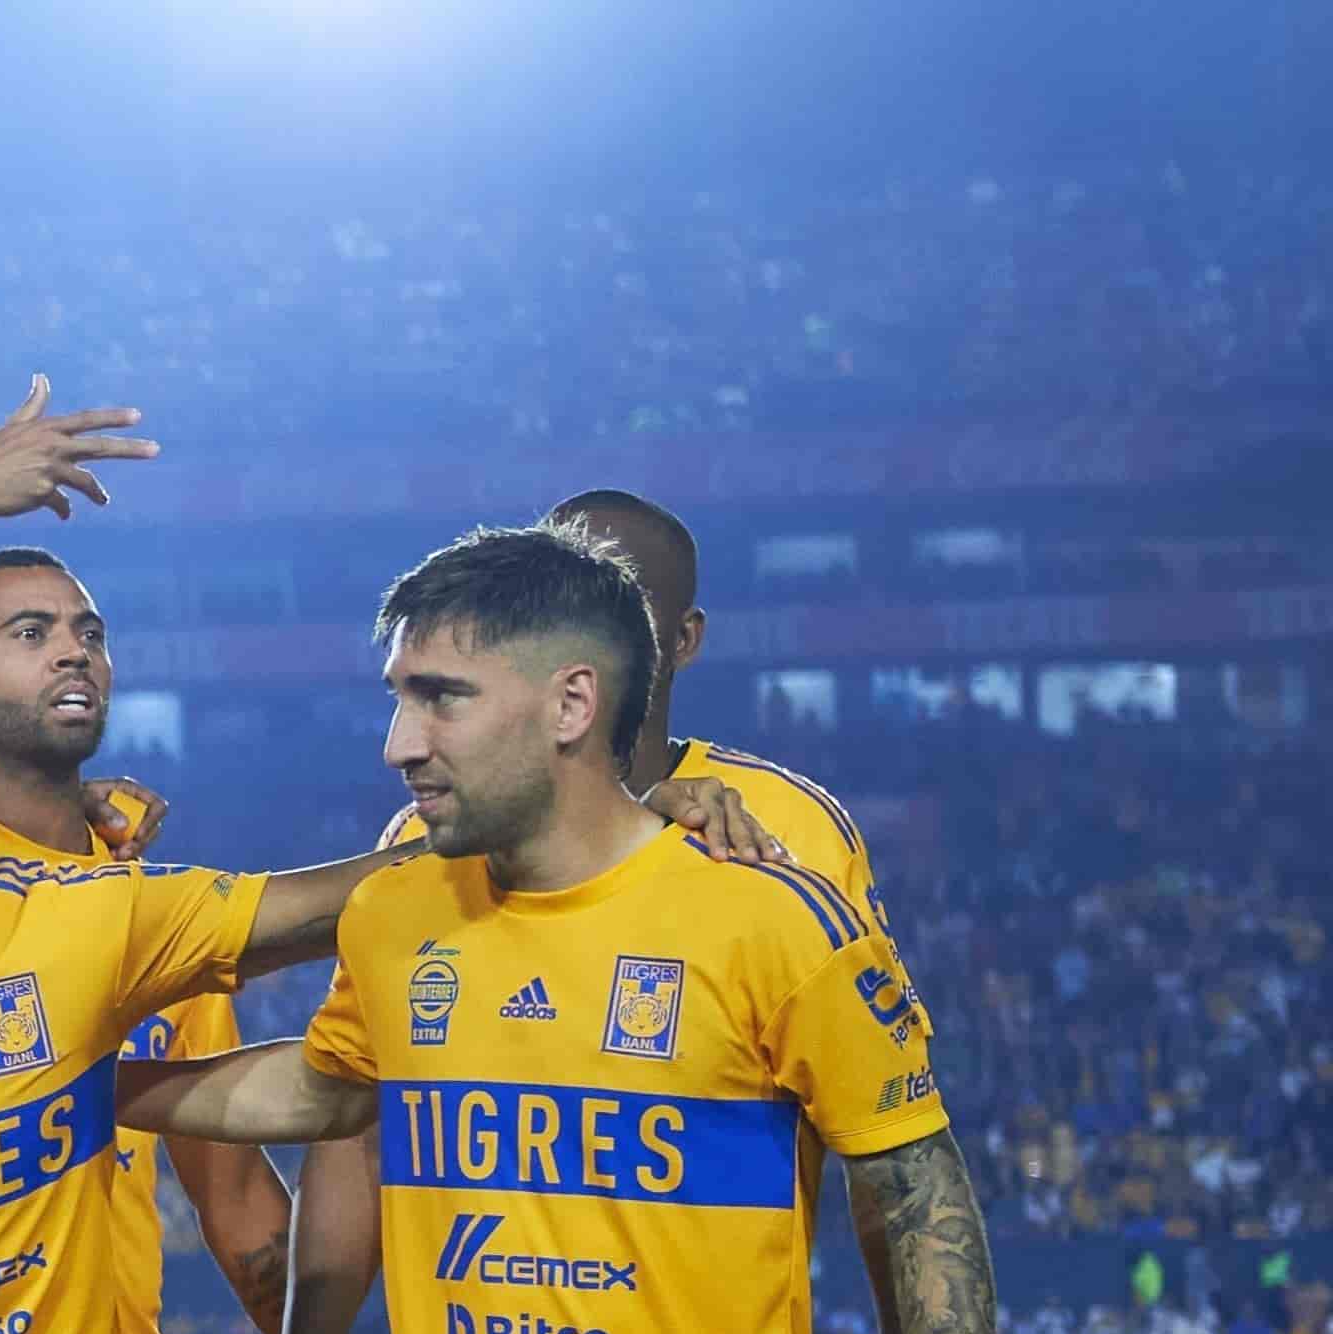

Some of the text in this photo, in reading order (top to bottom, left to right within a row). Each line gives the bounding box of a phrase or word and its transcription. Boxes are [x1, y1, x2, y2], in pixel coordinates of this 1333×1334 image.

[623, 963, 679, 981] TIGRES
[500, 1003, 557, 1019] adidas
[413, 1028, 444, 1041] EXTRA
[620, 1036, 657, 1050] UANL
[3, 1051, 38, 1067] UANL
[402, 1088, 686, 1194] TIGRES
[479, 1254, 637, 1291] CEMEX
